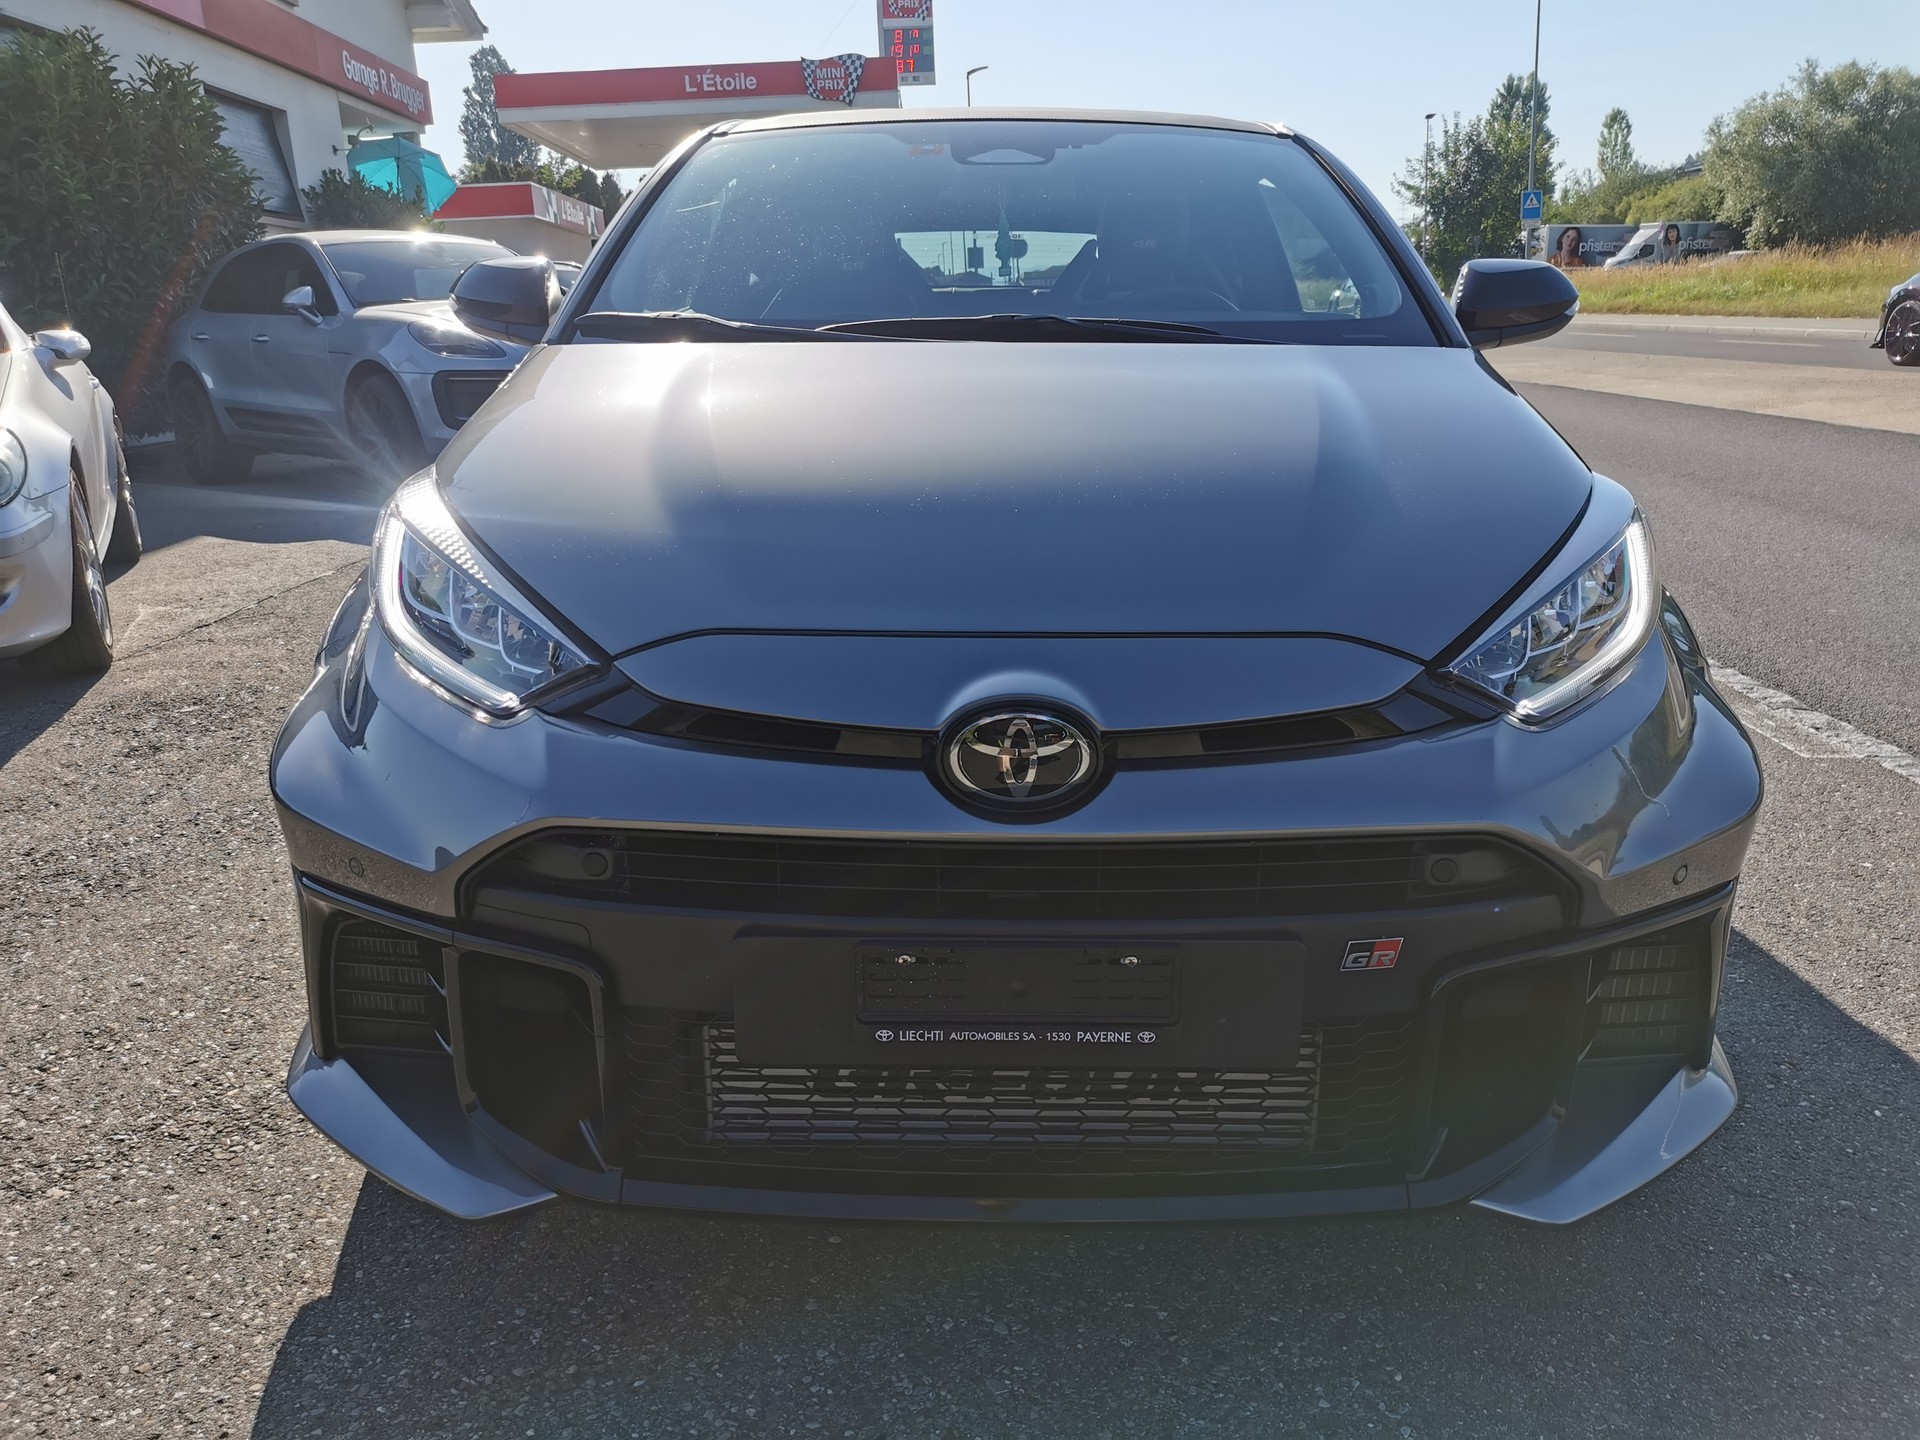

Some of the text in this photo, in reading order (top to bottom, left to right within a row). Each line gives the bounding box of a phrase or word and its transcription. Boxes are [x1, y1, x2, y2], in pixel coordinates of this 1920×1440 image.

[342, 50, 379, 95] Garage
[684, 69, 757, 92] L'Étoile
[816, 67, 845, 79] MINI
[817, 79, 846, 91] PRIX
[1578, 239, 1616, 256] pfister
[1678, 237, 1714, 256] pfister
[1345, 950, 1396, 968] GR
[899, 1030, 944, 1041] LIECHTI
[949, 1031, 1020, 1041] AUTOMOBILES
[1022, 1031, 1037, 1041] SA
[1046, 1031, 1072, 1041] 1530
[1076, 1031, 1132, 1043] PAYERNE
